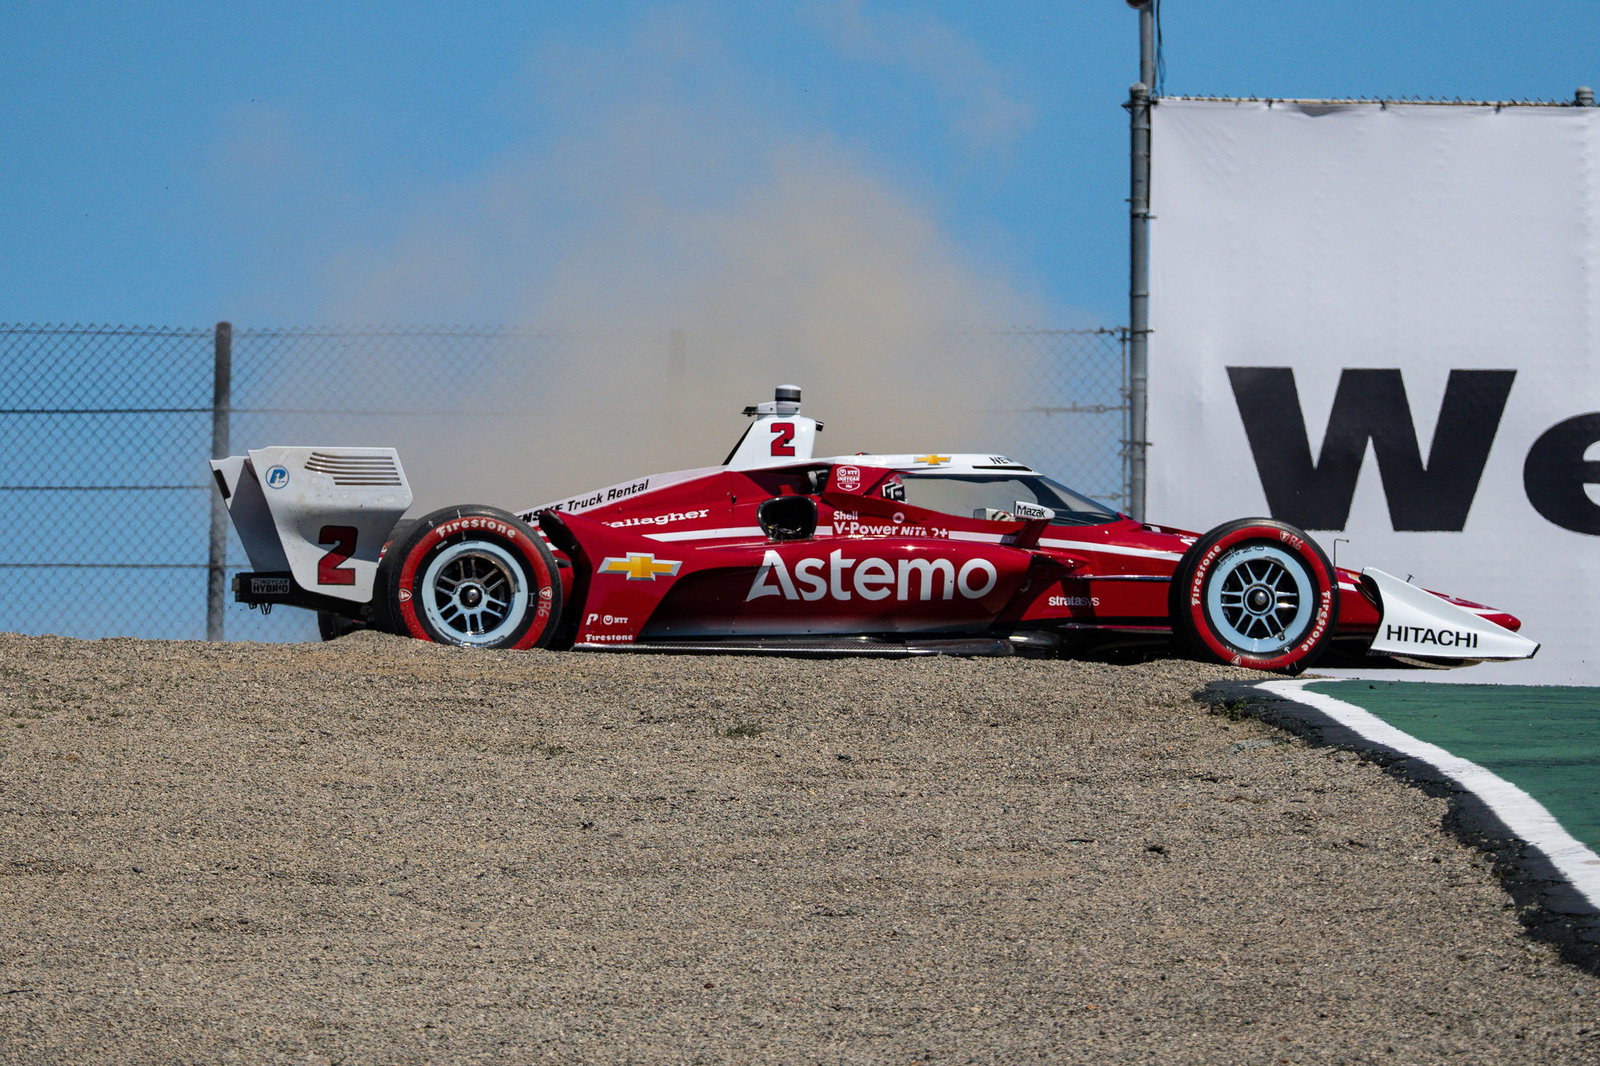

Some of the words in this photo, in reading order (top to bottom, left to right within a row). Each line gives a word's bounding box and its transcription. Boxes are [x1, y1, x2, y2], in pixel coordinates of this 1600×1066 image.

[770, 422, 795, 456] 2
[1225, 366, 1600, 537] We
[567, 493, 603, 512] Truck
[607, 479, 649, 501] Rental
[601, 508, 710, 528] allagher
[833, 510, 858, 521] Shell
[1016, 504, 1046, 519] Mazak
[435, 518, 517, 539] Firestone
[833, 521, 899, 536] V-Power
[1288, 535, 1303, 550] R6
[317, 525, 359, 586] 2
[746, 548, 998, 602] Astemo
[1191, 545, 1222, 607] Firestone
[252, 584, 289, 593] HYBRID
[537, 601, 552, 617] R6
[1048, 595, 1100, 608] stratasys
[1302, 590, 1331, 652] Firestone
[585, 634, 633, 642] Firestone
[1386, 624, 1478, 649] HITACHI
